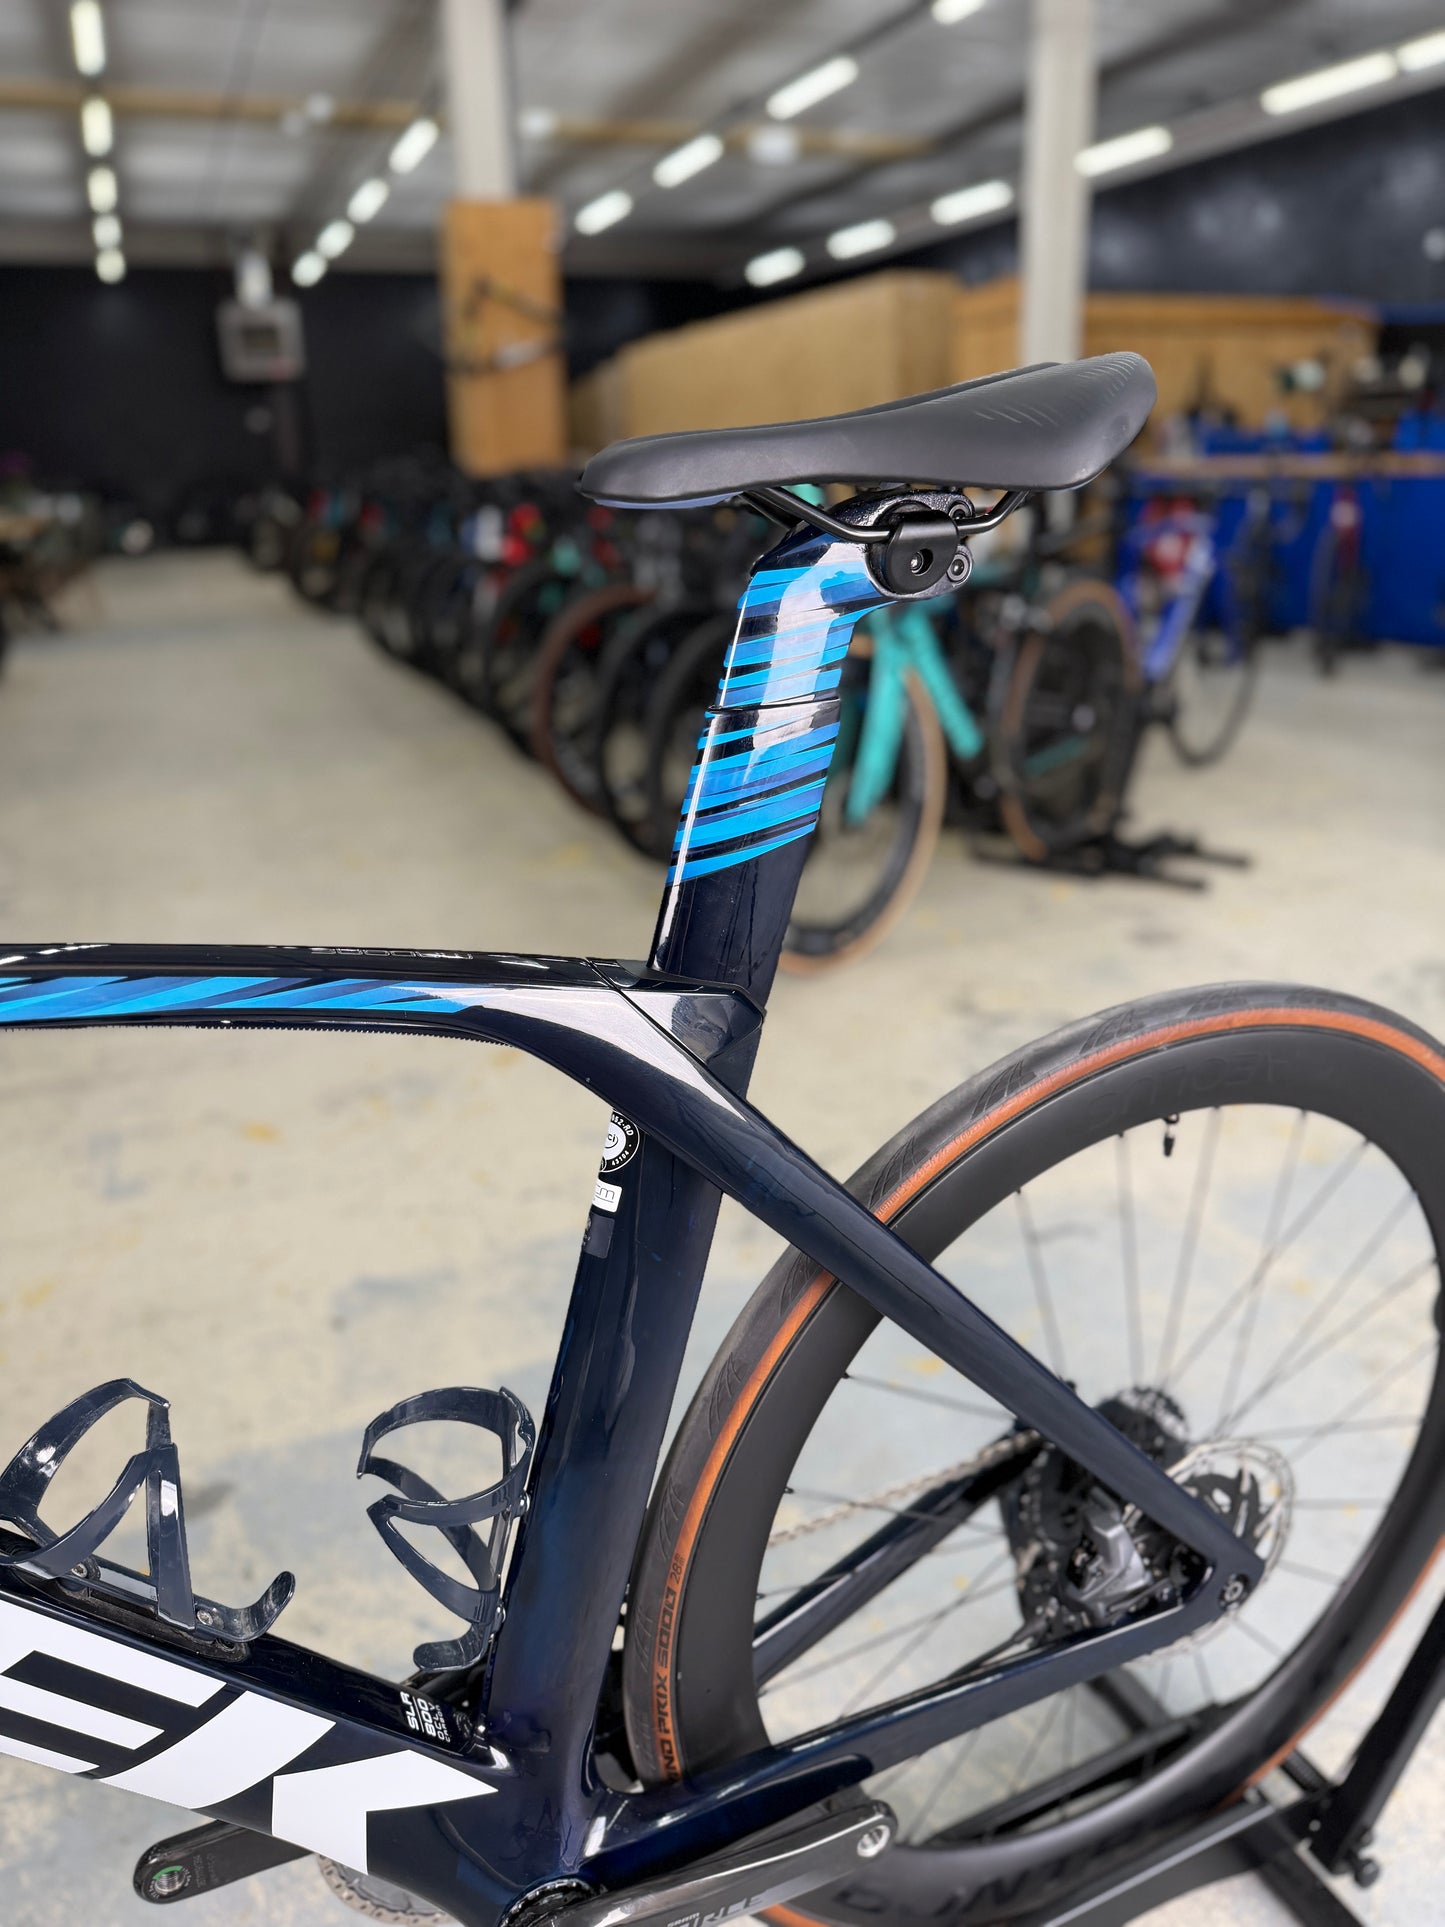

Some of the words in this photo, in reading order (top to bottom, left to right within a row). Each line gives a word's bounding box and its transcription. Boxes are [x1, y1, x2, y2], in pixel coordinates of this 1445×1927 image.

[656, 1587, 677, 1669] 5000
[416, 1698, 437, 1738] 800
[656, 1672, 670, 1735] PRIX
